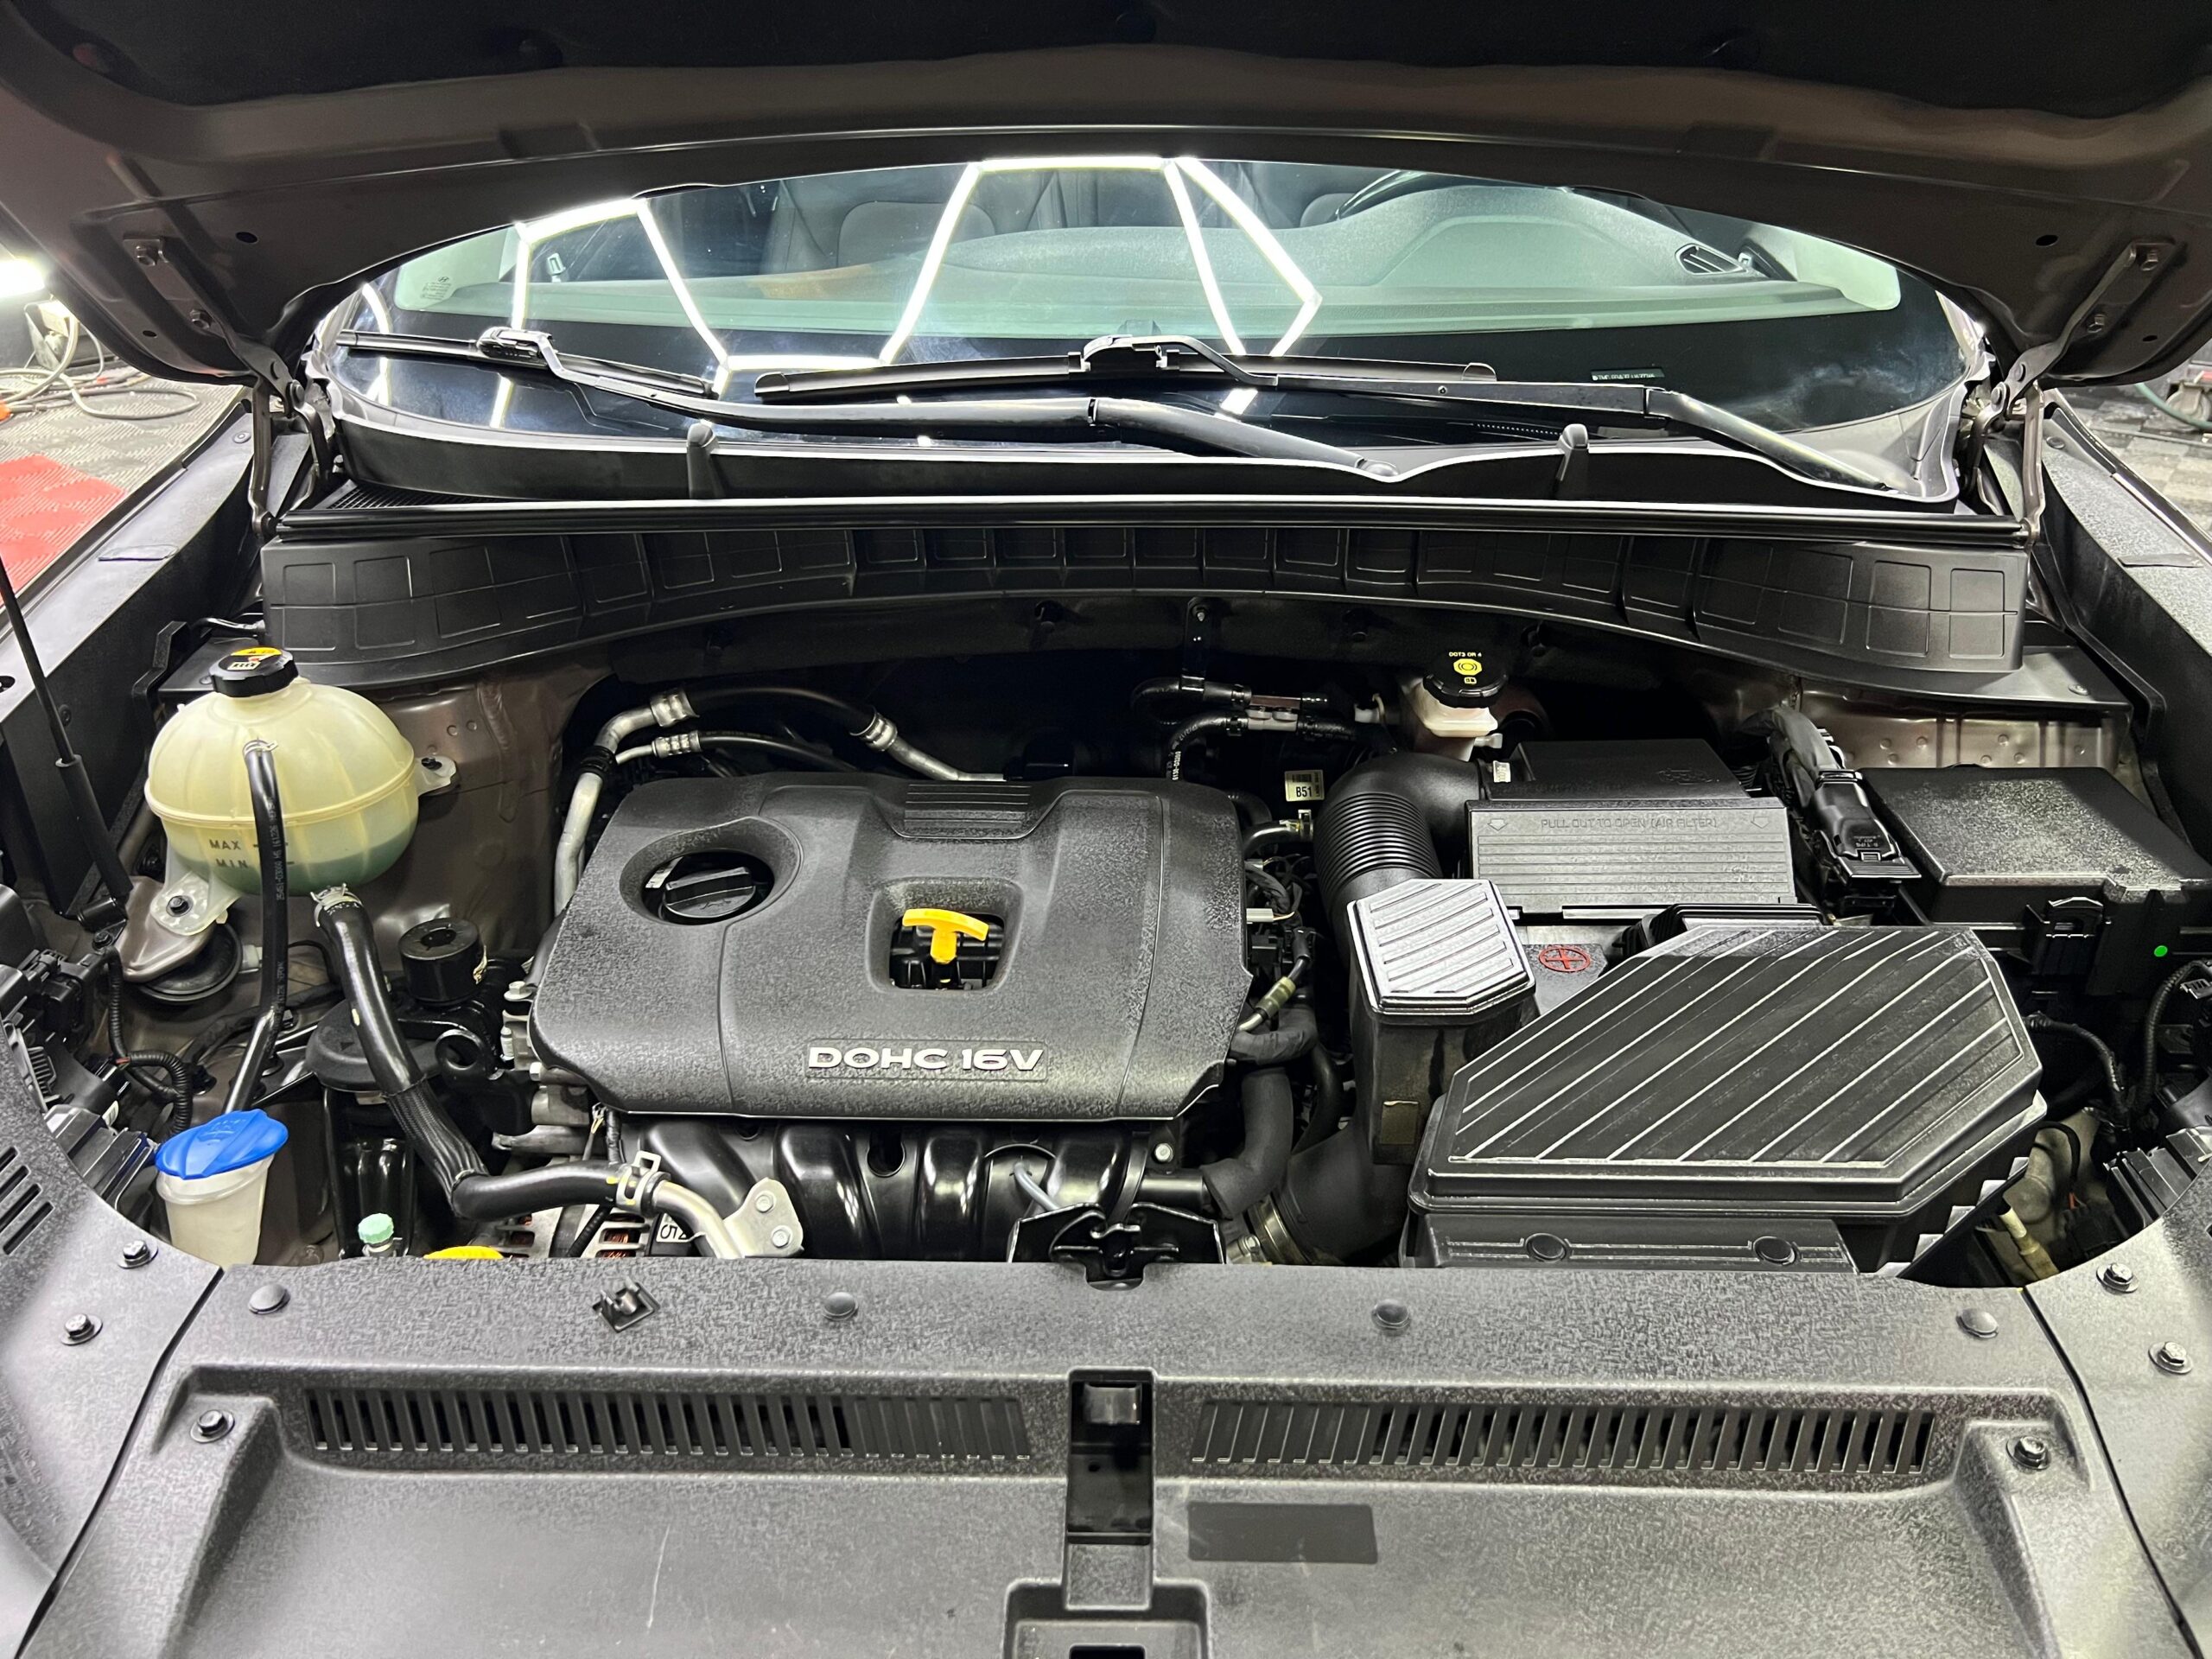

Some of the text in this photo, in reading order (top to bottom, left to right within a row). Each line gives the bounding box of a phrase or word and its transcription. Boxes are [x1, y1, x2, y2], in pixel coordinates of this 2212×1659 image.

[1296, 786, 1313, 798] B51
[1541, 819, 1570, 829] PULL
[1572, 818, 1595, 828] OUT
[1597, 818, 1611, 828] TO
[1615, 817, 1645, 828] OPEN
[209, 839, 241, 850] MAX
[216, 858, 249, 868] MIN
[809, 1046, 1044, 1071] DOHC 16V
